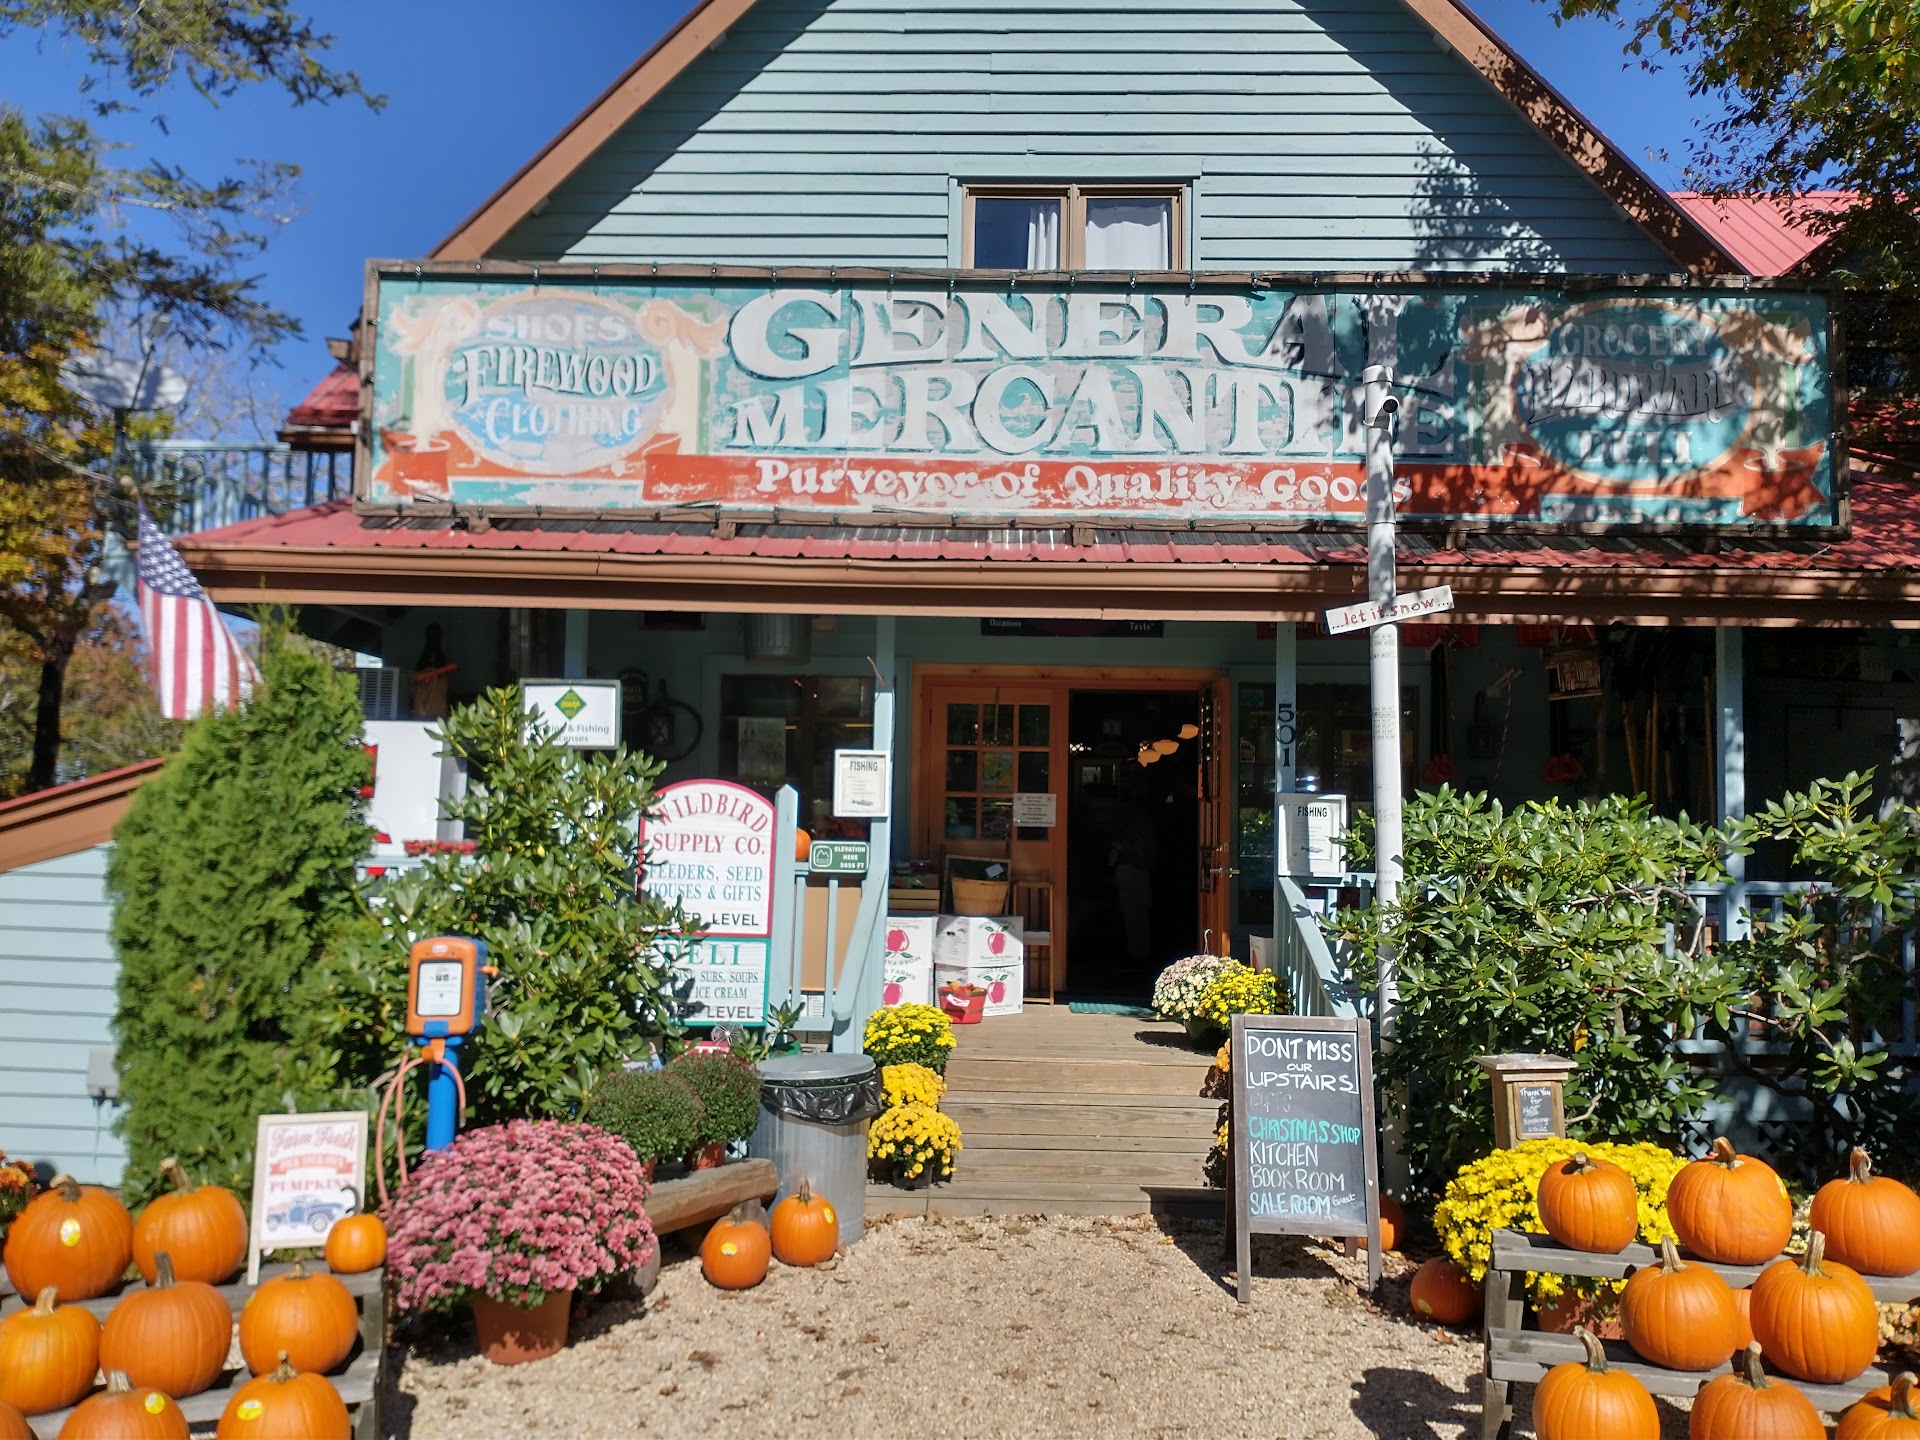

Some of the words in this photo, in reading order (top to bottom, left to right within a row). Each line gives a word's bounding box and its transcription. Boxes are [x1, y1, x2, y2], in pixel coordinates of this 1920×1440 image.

[487, 313, 629, 342] SHOES
[727, 288, 1454, 397] GENERAL
[1558, 324, 1711, 356] GROCERY
[461, 345, 657, 407] FIREWOOD
[486, 398, 642, 443] CLOTHING
[725, 366, 1454, 456] MERCANTILE
[756, 459, 979, 504] Purveyor
[991, 464, 1041, 498] of
[1064, 465, 1242, 508] Quality
[576, 724, 610, 735] Fishing
[849, 761, 879, 772] FISHING
[651, 792, 768, 834] WILDBIRD
[1297, 806, 1328, 818] FISHING
[653, 833, 725, 854] SUPPLY
[735, 836, 765, 856] CO.
[649, 863, 720, 883] FEEDERS,
[727, 865, 763, 882] SEED
[648, 882, 702, 900] HOUSES
[707, 885, 717, 900] &
[723, 885, 762, 902] GIFTS
[712, 913, 759, 926] LEVEL
[700, 971, 726, 984] SUBS,
[729, 971, 759, 984] SOUPS
[695, 987, 710, 998] ICE
[714, 987, 747, 999] CREAM
[706, 1005, 755, 1019] LEVEL
[1247, 1036, 1303, 1060] DONT
[1306, 1039, 1353, 1062] MISS
[1286, 1063, 1313, 1072] OUR
[1249, 1071, 1354, 1092] UPSTAIRS
[1249, 1116, 1330, 1143] CHRISTMAS
[1330, 1124, 1360, 1145] SHOP
[1250, 1140, 1319, 1167] KITCHEN
[1250, 1164, 1294, 1189] BOOK
[1295, 1169, 1345, 1192] ROOM
[1249, 1192, 1289, 1215] SALE
[1290, 1194, 1331, 1215] ROOM
